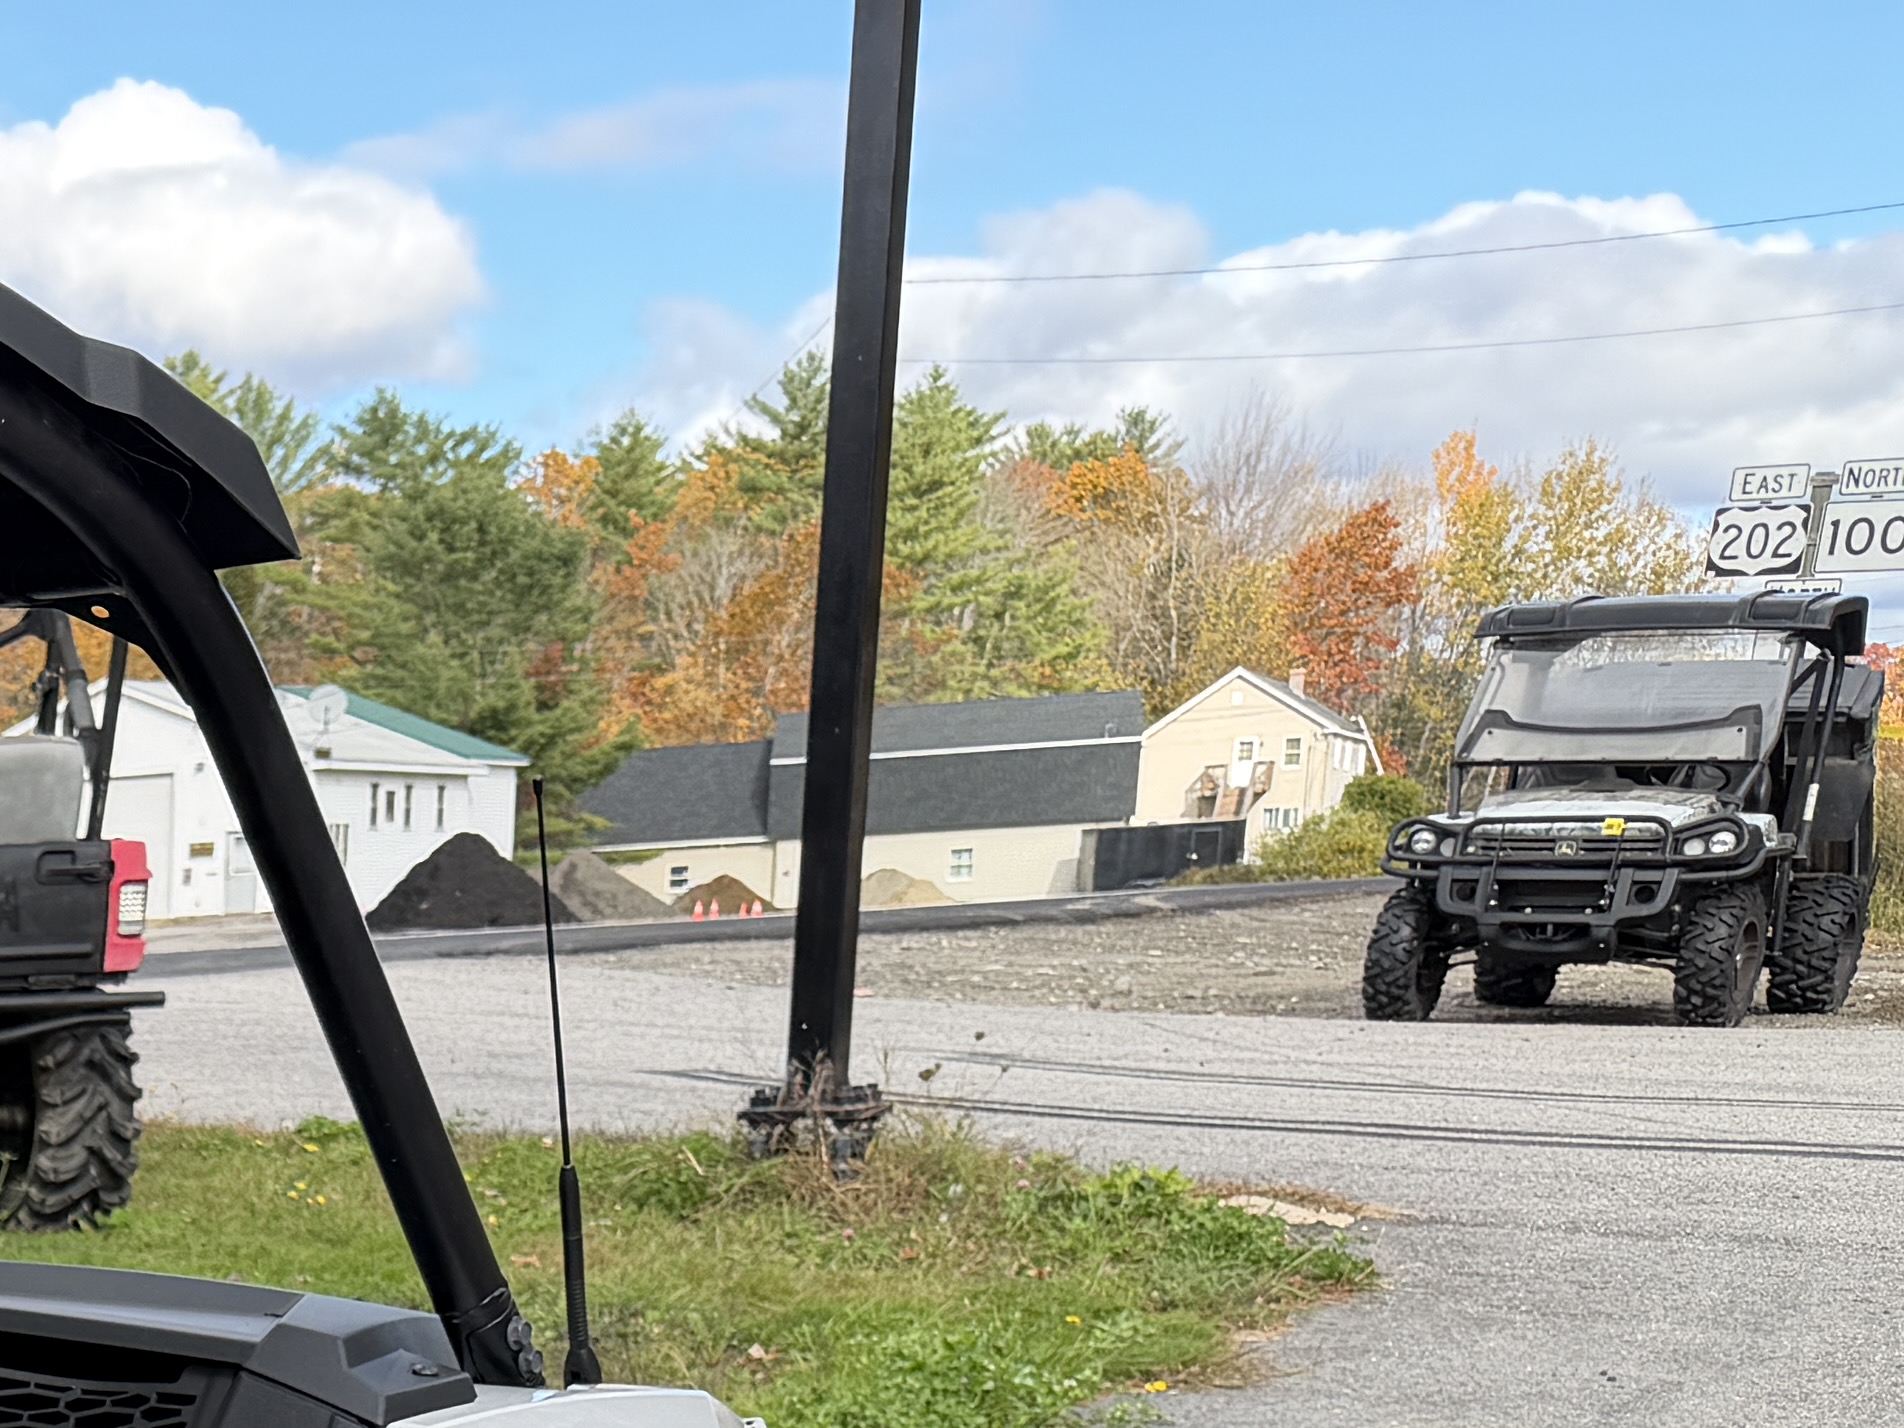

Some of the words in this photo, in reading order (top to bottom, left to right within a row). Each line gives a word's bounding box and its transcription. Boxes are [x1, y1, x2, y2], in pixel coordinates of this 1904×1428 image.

[1741, 472, 1798, 495] EAST
[1845, 465, 1904, 489] NORT
[1718, 520, 1798, 561] 202
[1827, 515, 1904, 556] 100
